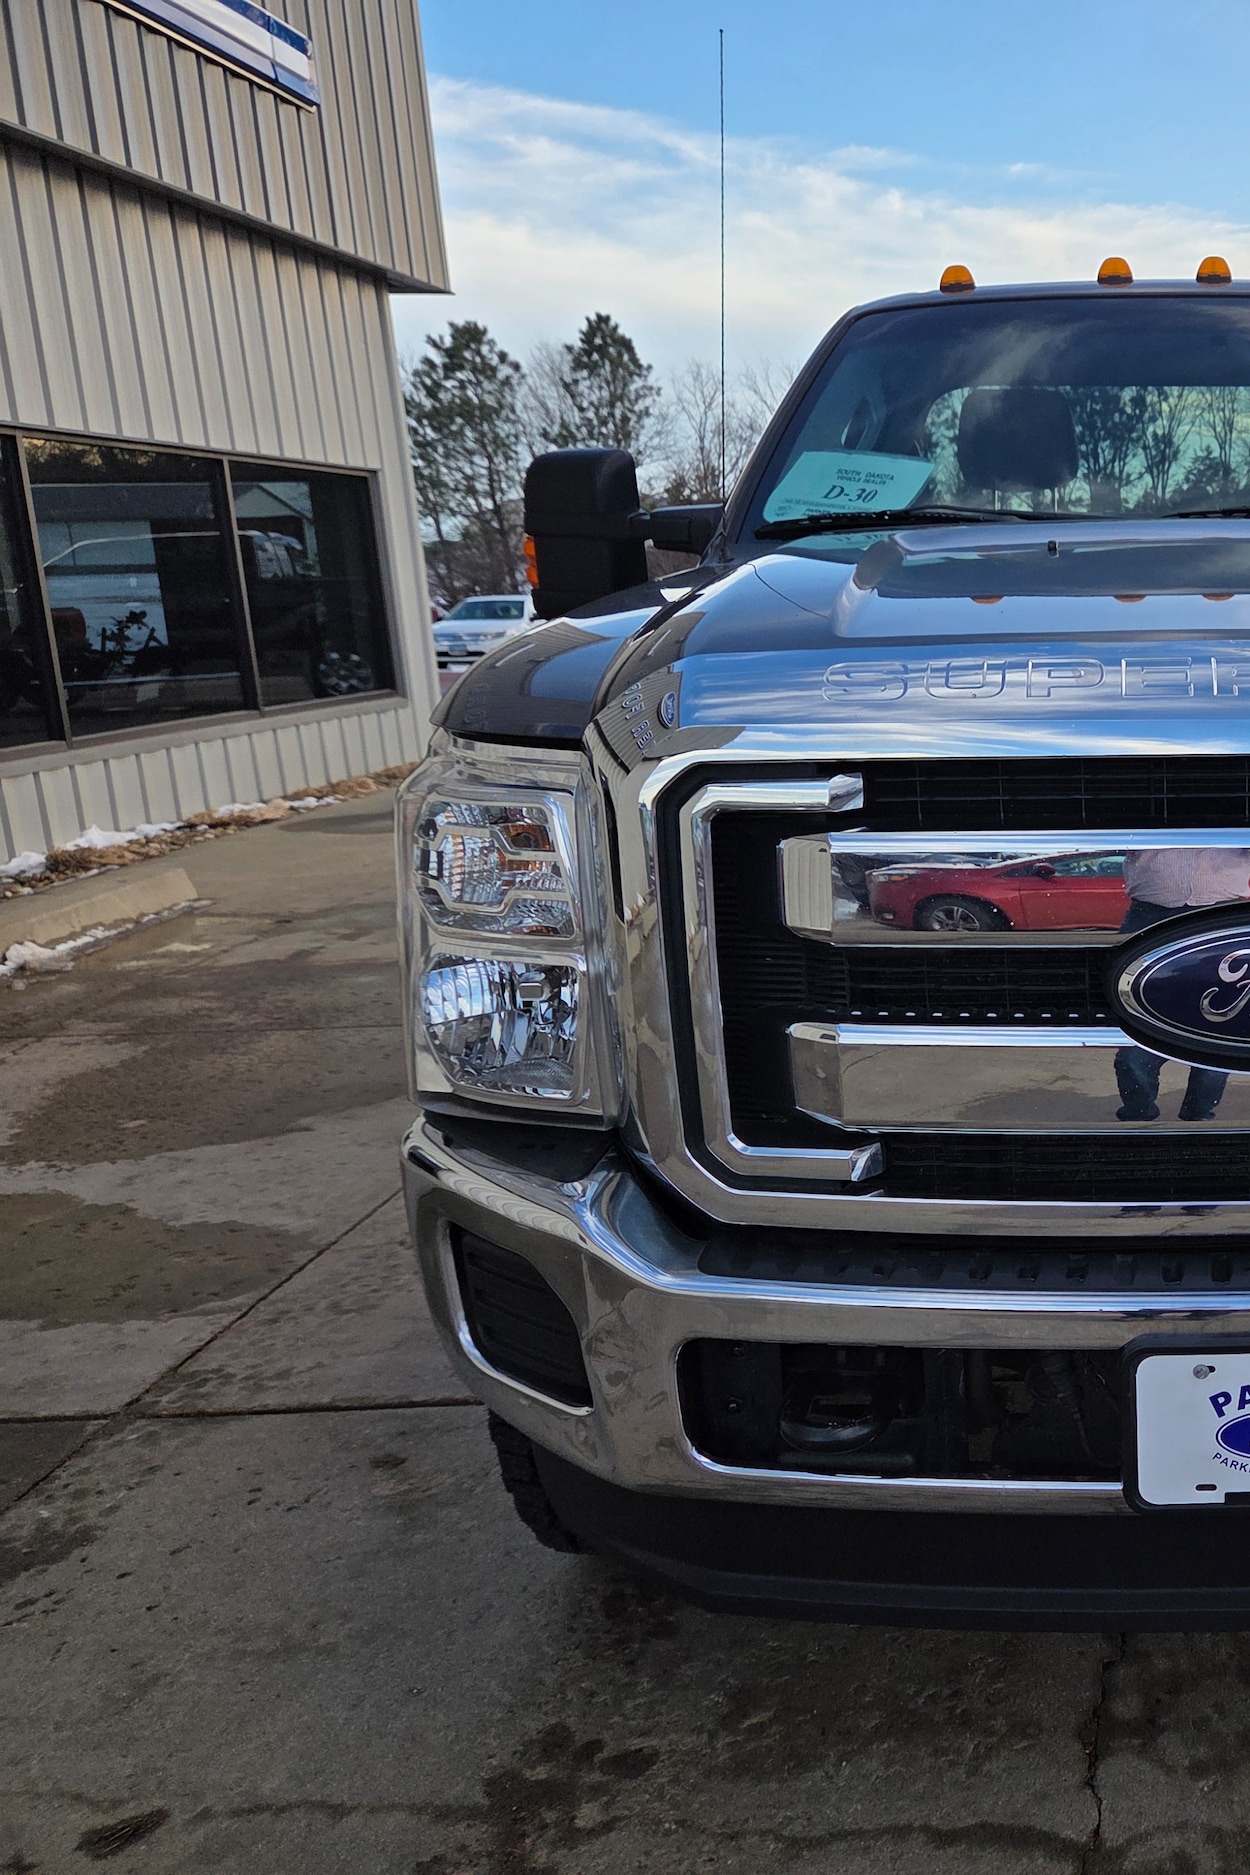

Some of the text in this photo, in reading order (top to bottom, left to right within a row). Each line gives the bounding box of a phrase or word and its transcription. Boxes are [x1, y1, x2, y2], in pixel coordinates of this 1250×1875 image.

[836, 468, 894, 480] SOUTH DAKOTA
[822, 485, 878, 503] D-30
